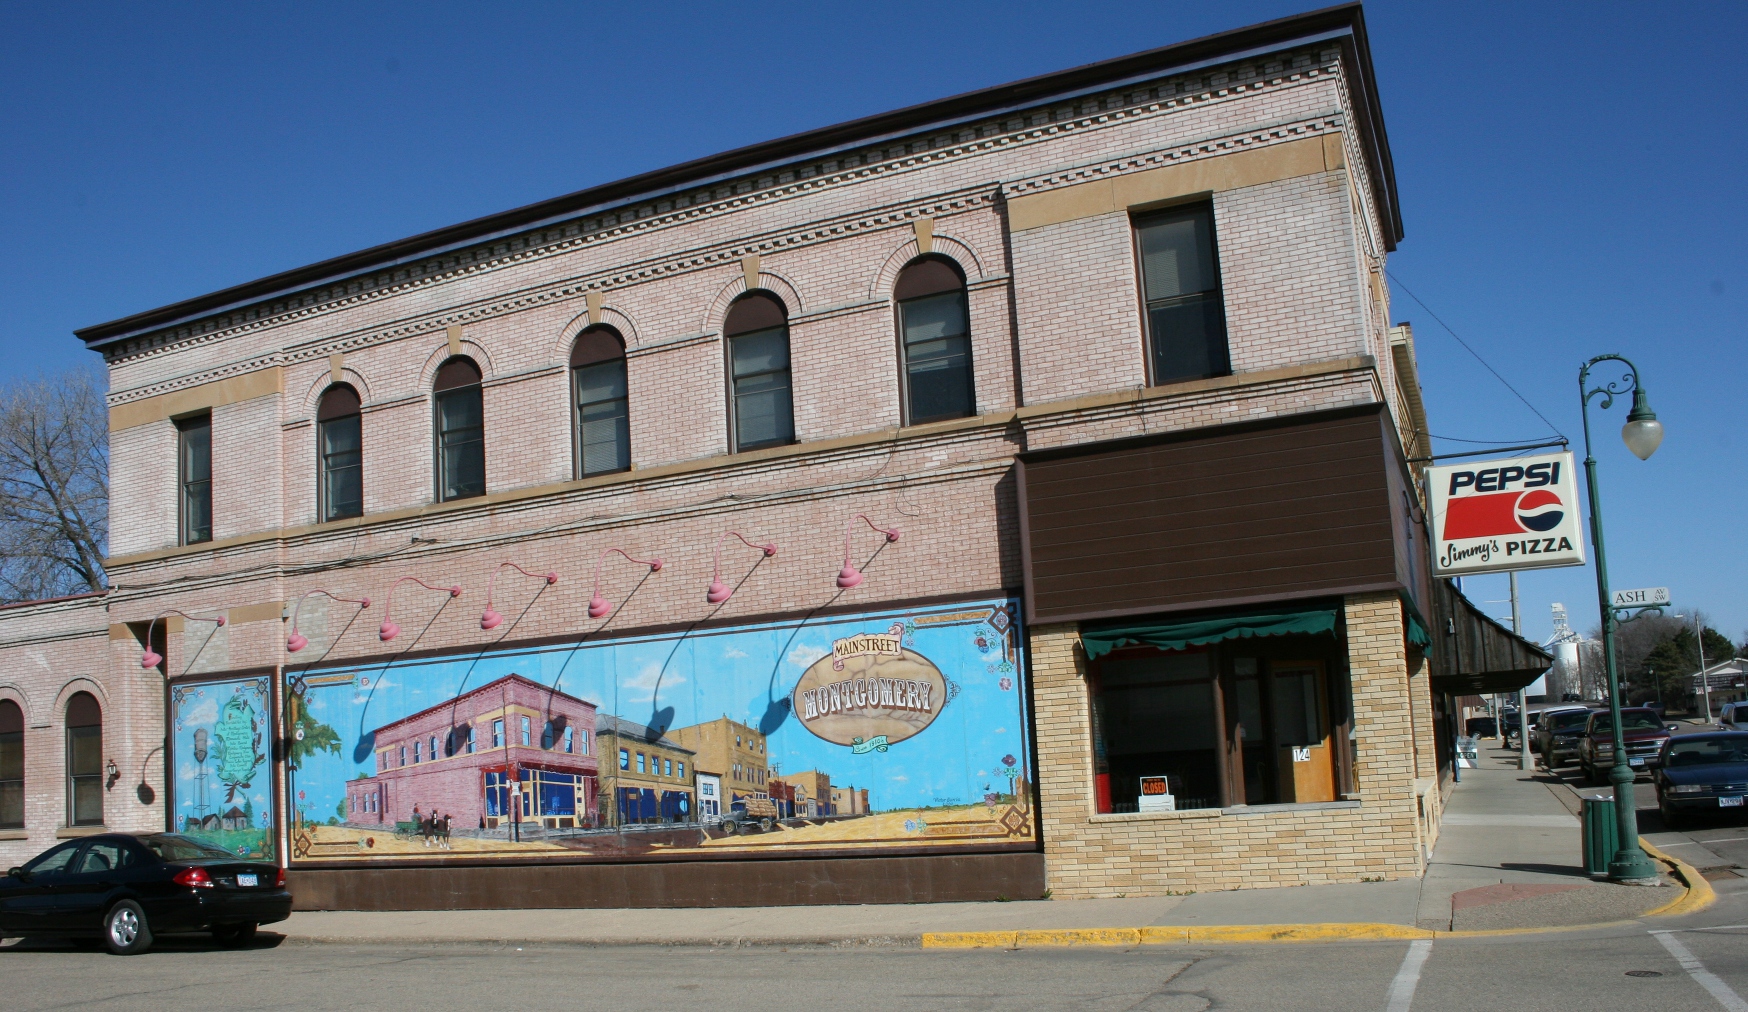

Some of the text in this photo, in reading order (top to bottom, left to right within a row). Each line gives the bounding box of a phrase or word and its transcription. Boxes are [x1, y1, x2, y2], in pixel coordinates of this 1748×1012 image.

[1449, 461, 1561, 496] PEPSI
[1441, 537, 1573, 568] Jimmy's PIZZA
[1615, 591, 1646, 604] ASH
[834, 638, 899, 658] MAINSTREET
[802, 677, 933, 722] MONTGOMERY
[1295, 749, 1310, 761] 124
[1143, 781, 1166, 795] CLOSED
